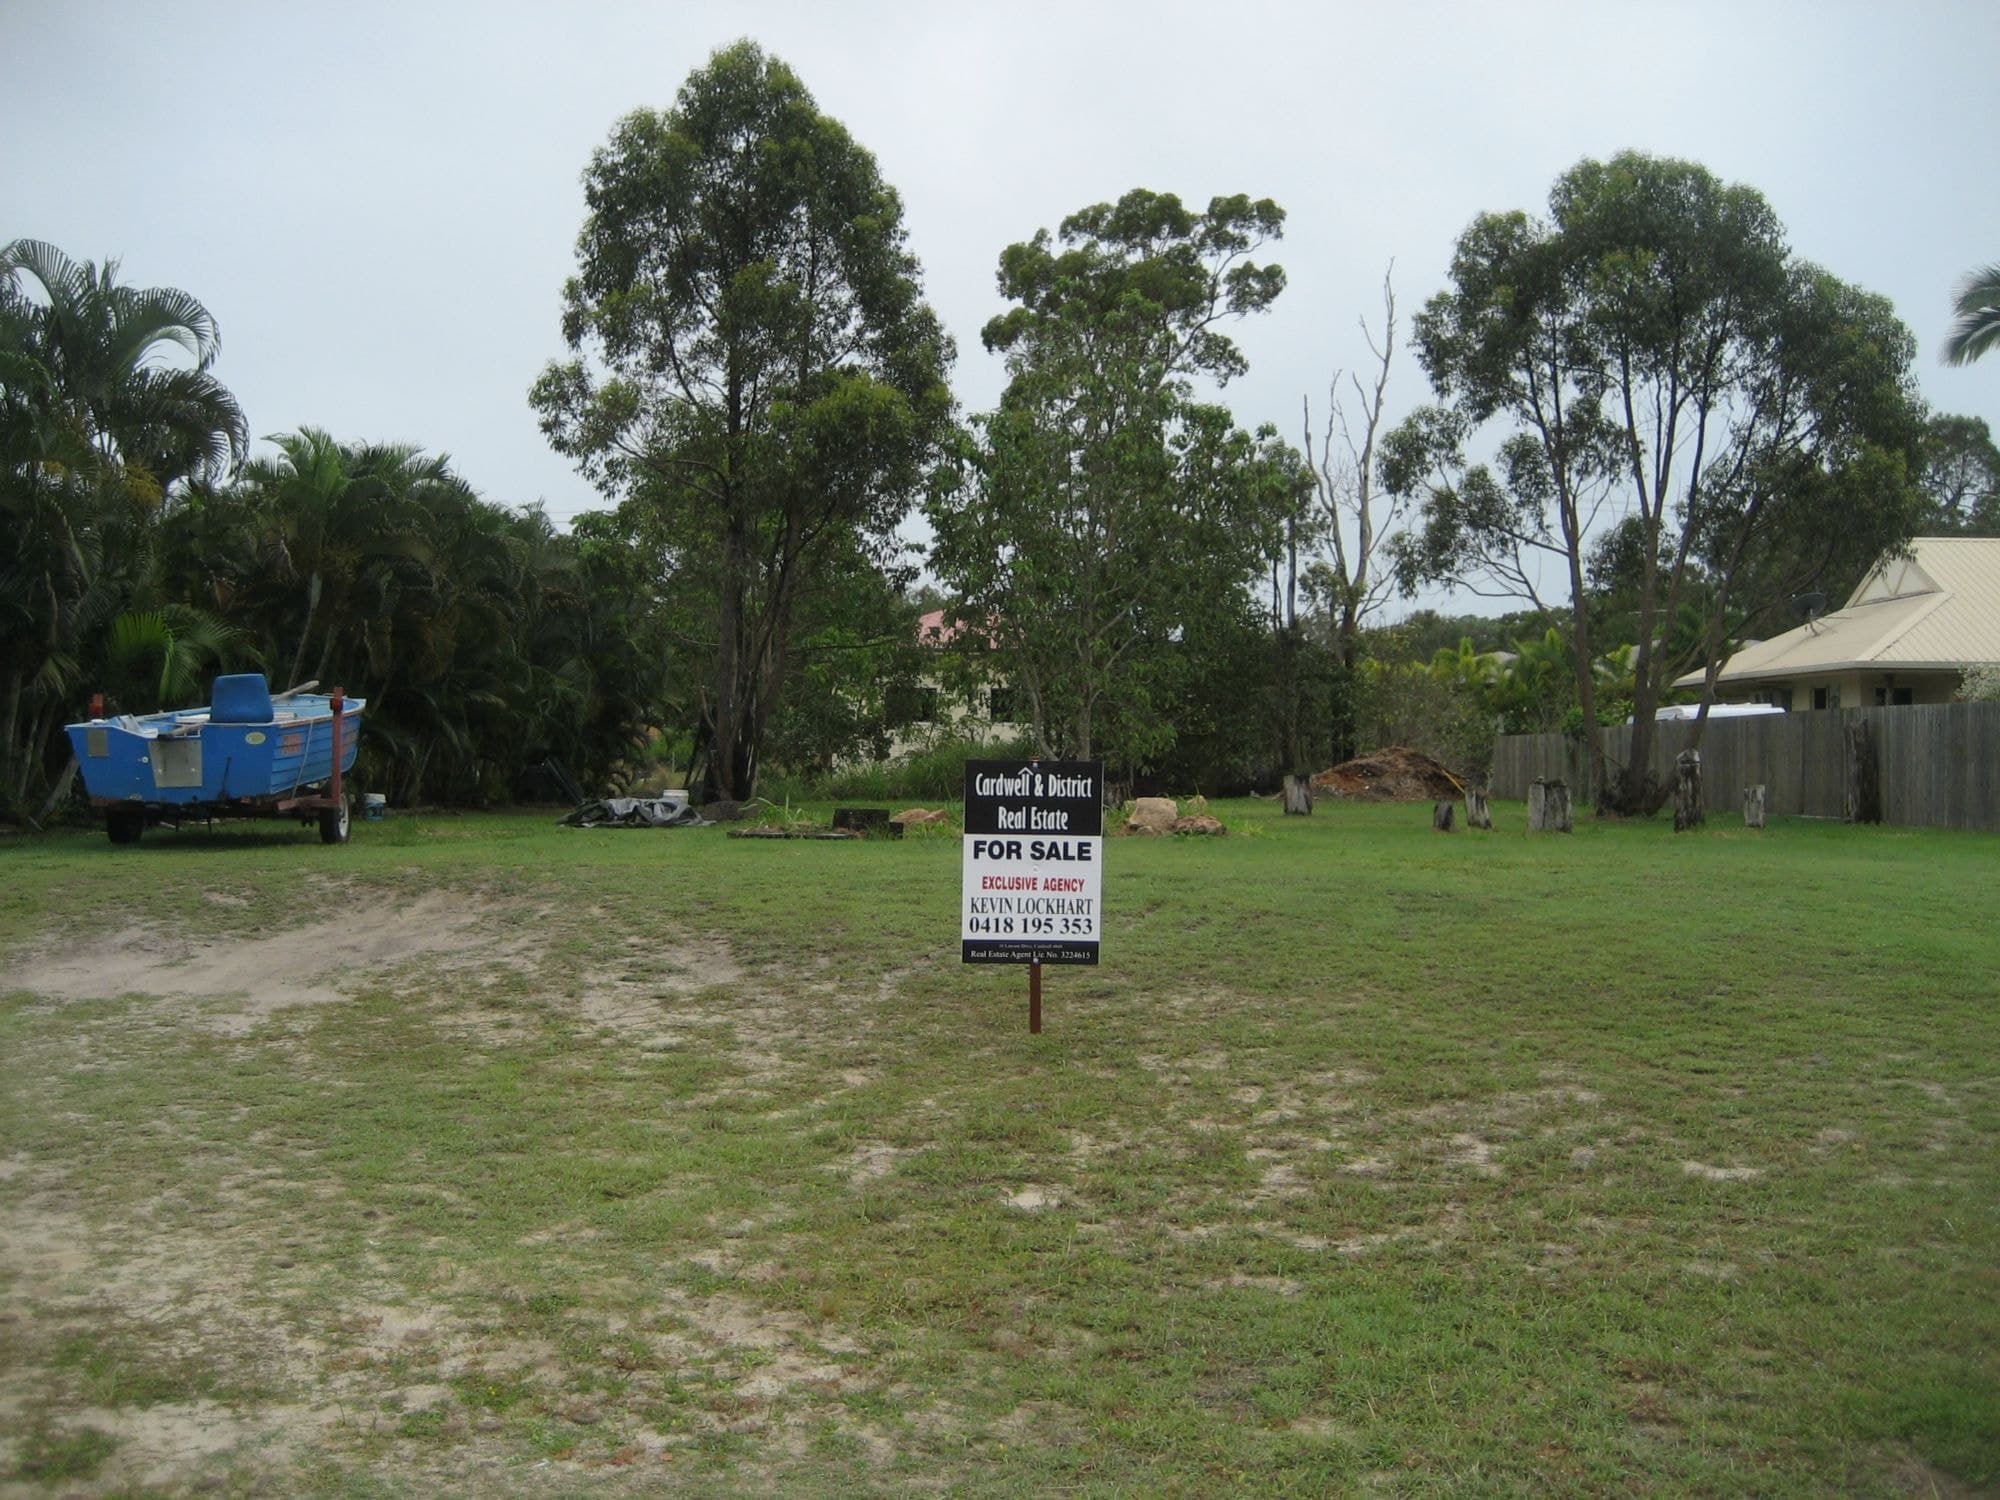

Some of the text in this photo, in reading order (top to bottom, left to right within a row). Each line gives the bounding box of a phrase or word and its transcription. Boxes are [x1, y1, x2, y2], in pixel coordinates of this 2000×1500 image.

[975, 773, 1092, 798] Cardwell & District
[998, 806, 1068, 830] Real Estate
[973, 840, 1092, 861] FOR SALE
[982, 876, 1085, 892] EXCLUSIVE AGENCY
[970, 897, 1093, 915] KEVIN LOCKHART
[969, 917, 1093, 934] 0418 195 353
[970, 950, 987, 958] Real
[988, 950, 1008, 958] Estate
[1011, 951, 1031, 960] Agent
